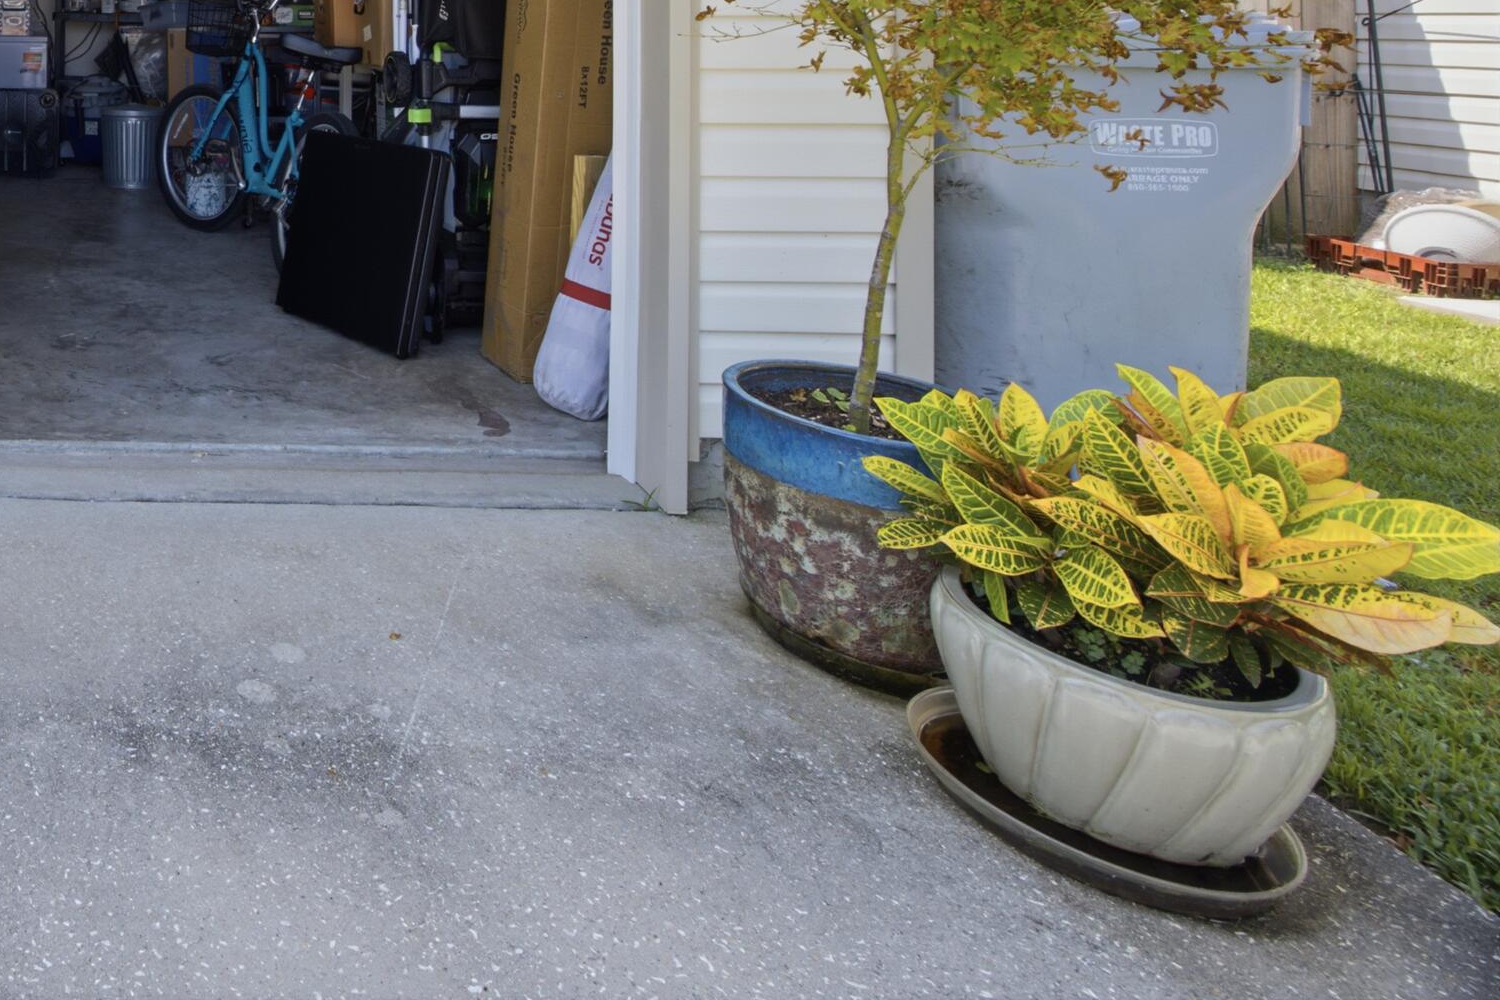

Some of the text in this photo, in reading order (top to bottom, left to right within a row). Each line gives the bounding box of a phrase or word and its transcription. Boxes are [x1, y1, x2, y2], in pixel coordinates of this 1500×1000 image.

[597, 35, 612, 85] House
[507, 72, 521, 173] Green House
[1171, 123, 1212, 147] PRO
[1170, 175, 1200, 184] ONLY
